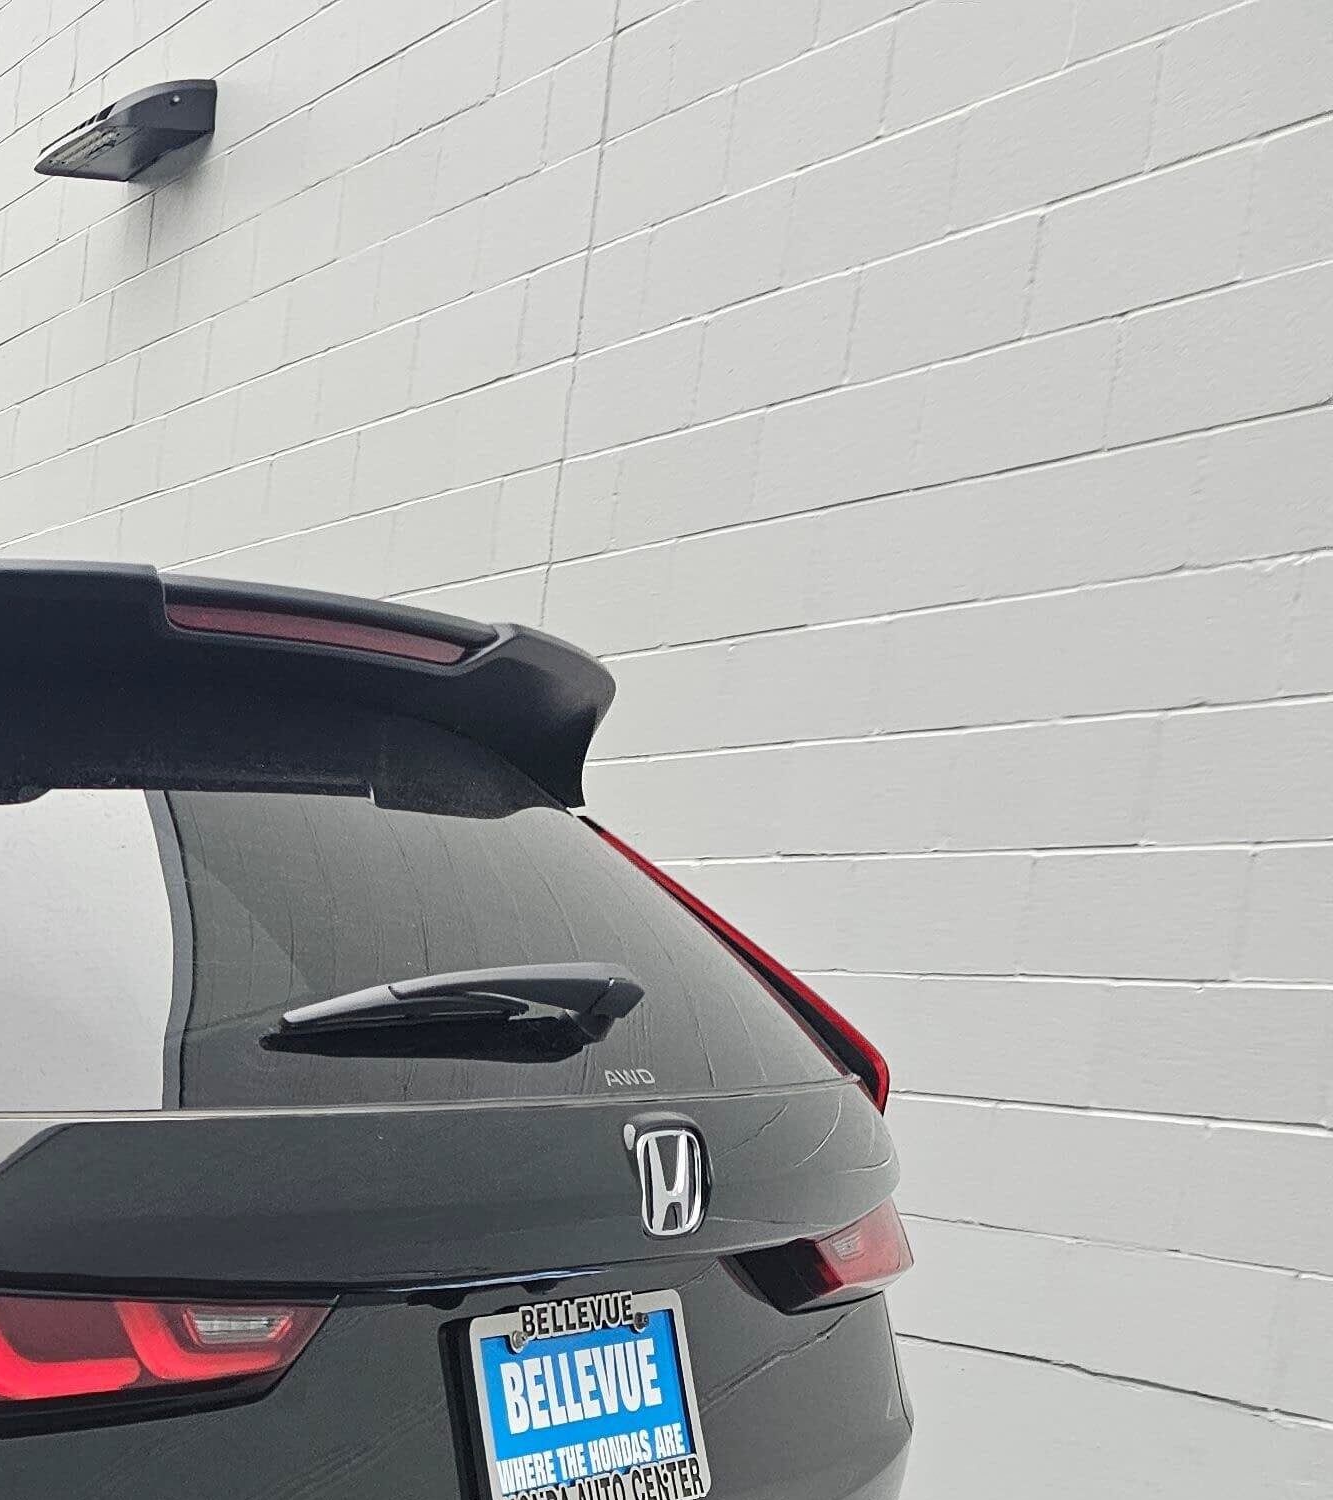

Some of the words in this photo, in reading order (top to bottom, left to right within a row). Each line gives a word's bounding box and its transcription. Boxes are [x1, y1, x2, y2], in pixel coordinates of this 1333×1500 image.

[604, 1068, 656, 1087] AWD
[520, 1293, 633, 1337] BELLEVUE
[500, 1338, 662, 1435] BELLEVUE
[496, 1453, 556, 1495] WHERE
[556, 1442, 588, 1480] THE
[588, 1429, 652, 1474] HONDAS
[654, 1422, 686, 1459] ARE
